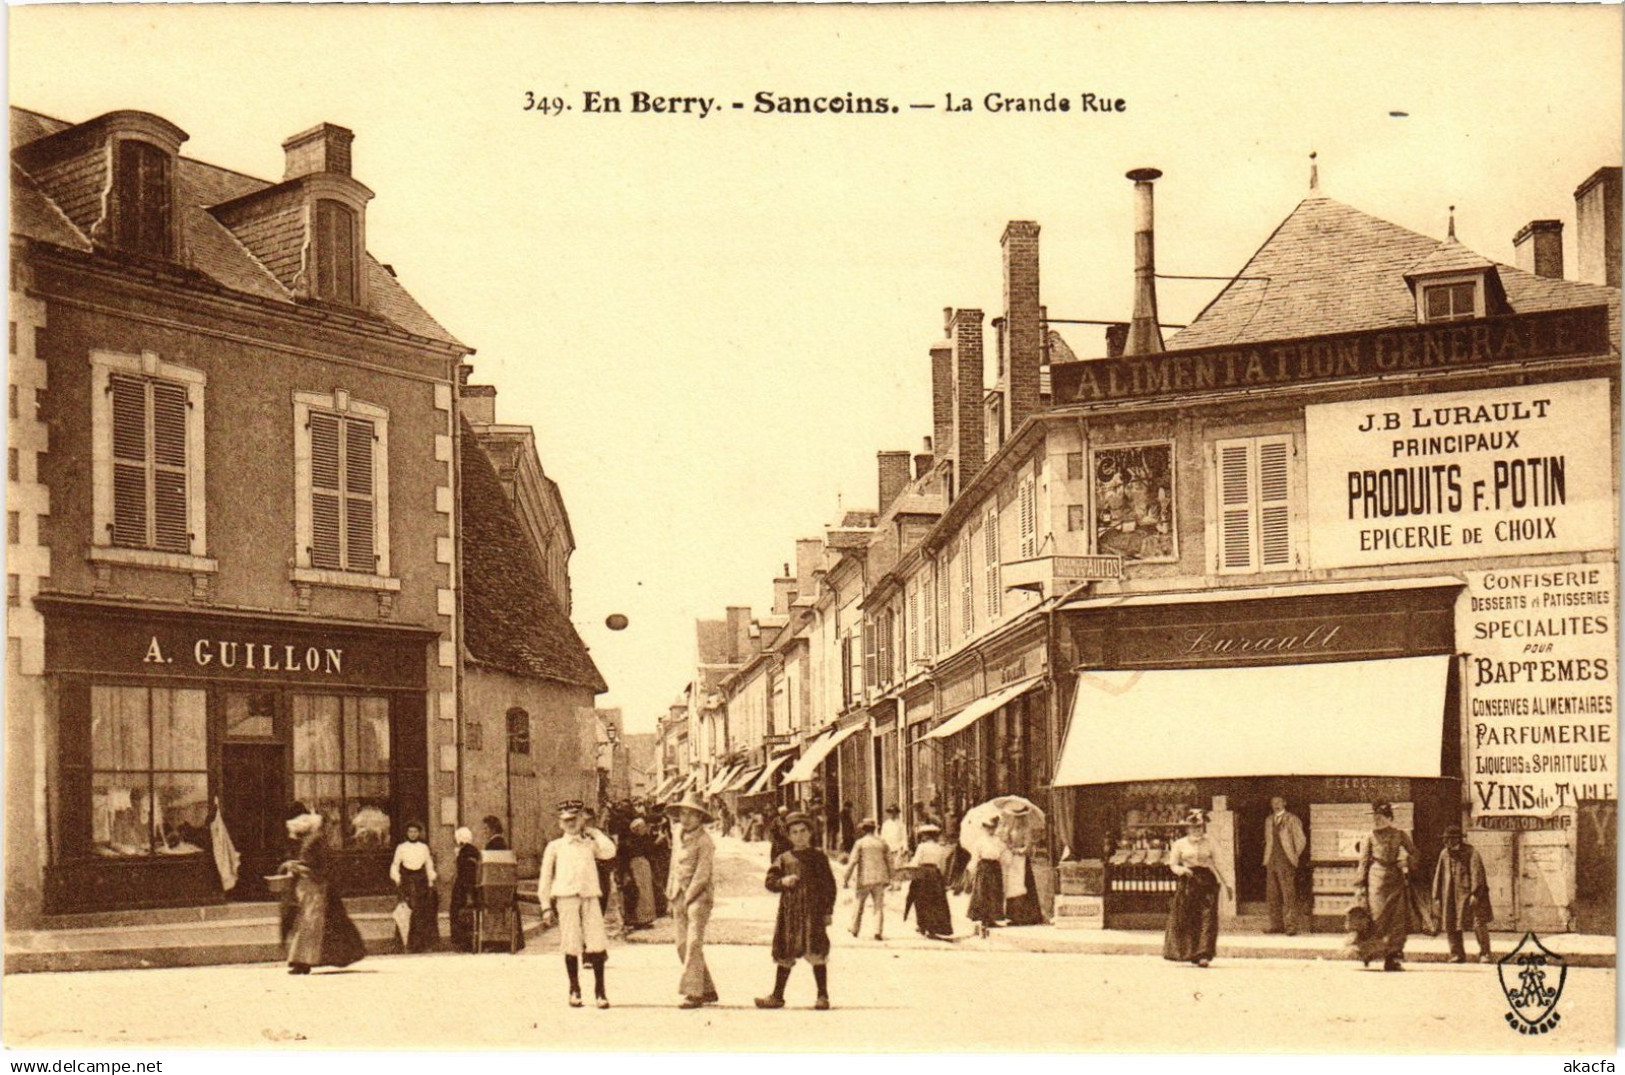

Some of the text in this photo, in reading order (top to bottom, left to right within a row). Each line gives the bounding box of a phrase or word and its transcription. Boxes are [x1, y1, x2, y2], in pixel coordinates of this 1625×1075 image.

[1073, 337, 1361, 401] ALIMENTATION
[1358, 399, 1551, 432] J.B LURAULT
[1392, 430, 1520, 458] PRINCIPAUX
[1347, 455, 1566, 520] PRODUITS F. POTIN
[1360, 516, 1557, 552] EPICERIE DE CHOIX
[1087, 559, 1119, 577] AUTOS
[1483, 570, 1600, 590] CONFISERIE
[1471, 596, 1527, 612] DESSERTS
[1543, 591, 1610, 607] PATISSERIES
[1182, 624, 1342, 655] Lurault
[1474, 615, 1609, 639] SPECIALITES
[143, 636, 343, 674] A. GUILLON
[1523, 642, 1554, 653] POUR
[1474, 657, 1609, 687] BAPTEMES
[1472, 695, 1613, 716] CONSERVES ALIMENTAIRES
[1475, 722, 1612, 749] PARFUMERIE
[1475, 756, 1524, 776] LIQUEURS
[1532, 753, 1609, 774] SPIRITUEUX
[1473, 780, 1536, 811] VINS
[1536, 788, 1553, 809] de
